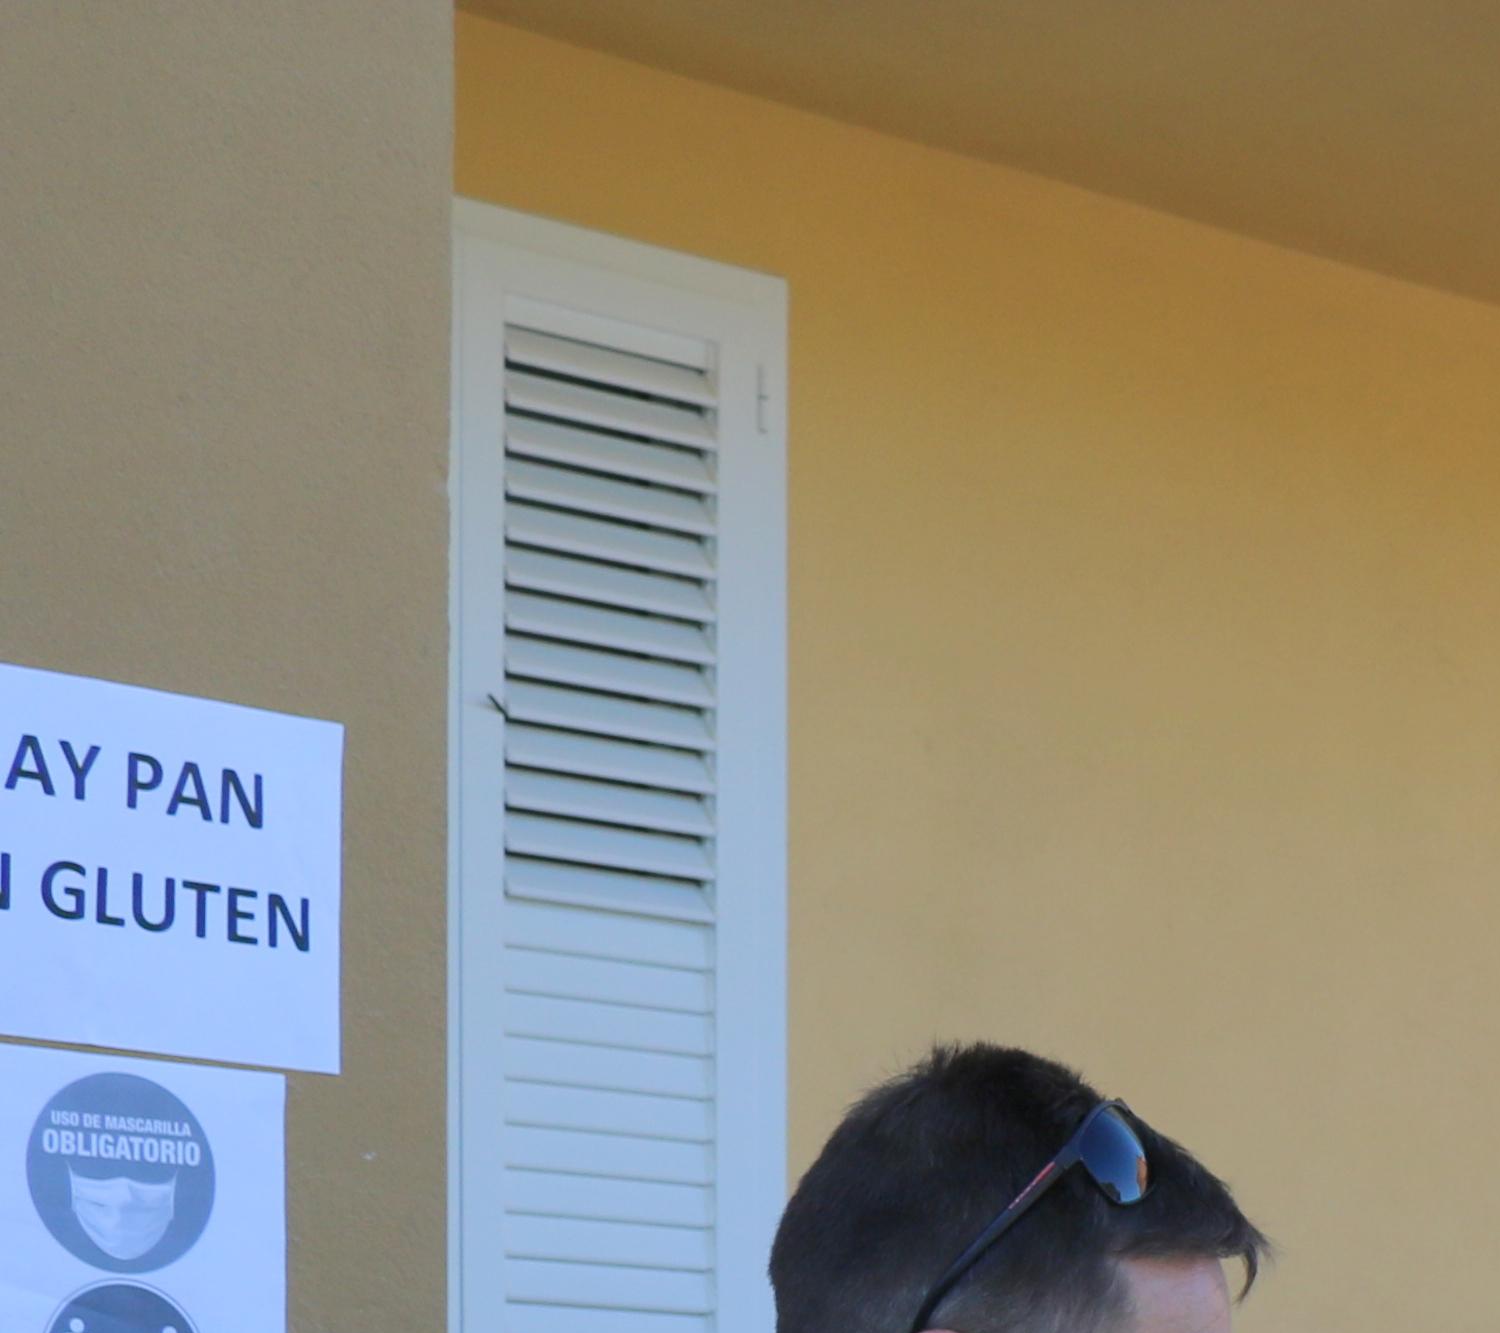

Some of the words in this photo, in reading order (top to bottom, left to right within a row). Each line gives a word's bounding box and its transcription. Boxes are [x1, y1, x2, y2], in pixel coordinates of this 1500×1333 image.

[4, 734, 101, 801] AY
[126, 751, 263, 829] PAN
[40, 861, 311, 952] GLUTEN
[42, 1128, 201, 1166] OBLIGATORIO
[51, 1110, 79, 1126] USO
[83, 1113, 101, 1129] DE
[104, 1115, 192, 1137] MASCARILLA
